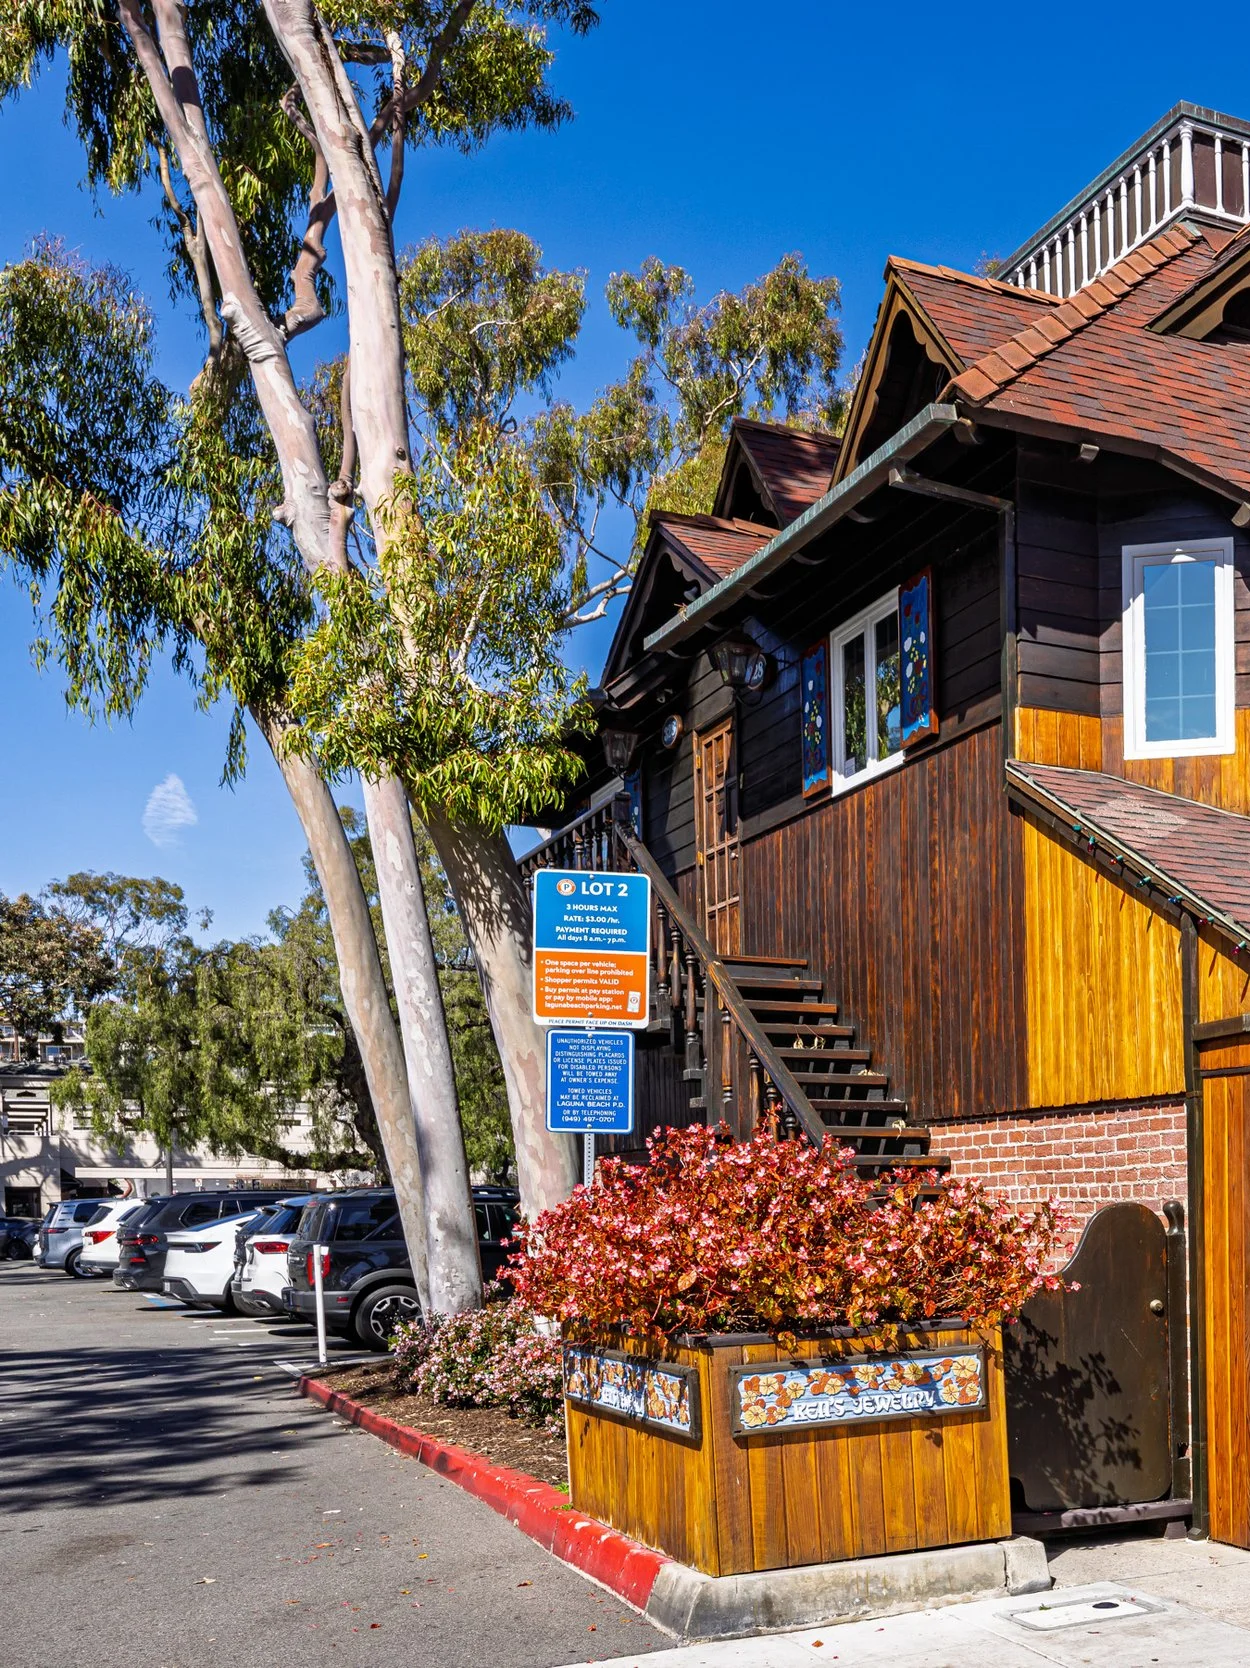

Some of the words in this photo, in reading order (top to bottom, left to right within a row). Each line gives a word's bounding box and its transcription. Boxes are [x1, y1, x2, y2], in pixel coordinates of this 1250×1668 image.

[581, 881, 614, 896] LOT
[617, 883, 629, 897] 2
[591, 928, 628, 936] REQUIRED
[545, 967, 570, 975] parking
[545, 976, 572, 984] Shopper
[545, 986, 556, 994] Buy
[545, 1002, 622, 1010] lagunabeachparking.net
[851, 1390, 936, 1415] JEWELRY
